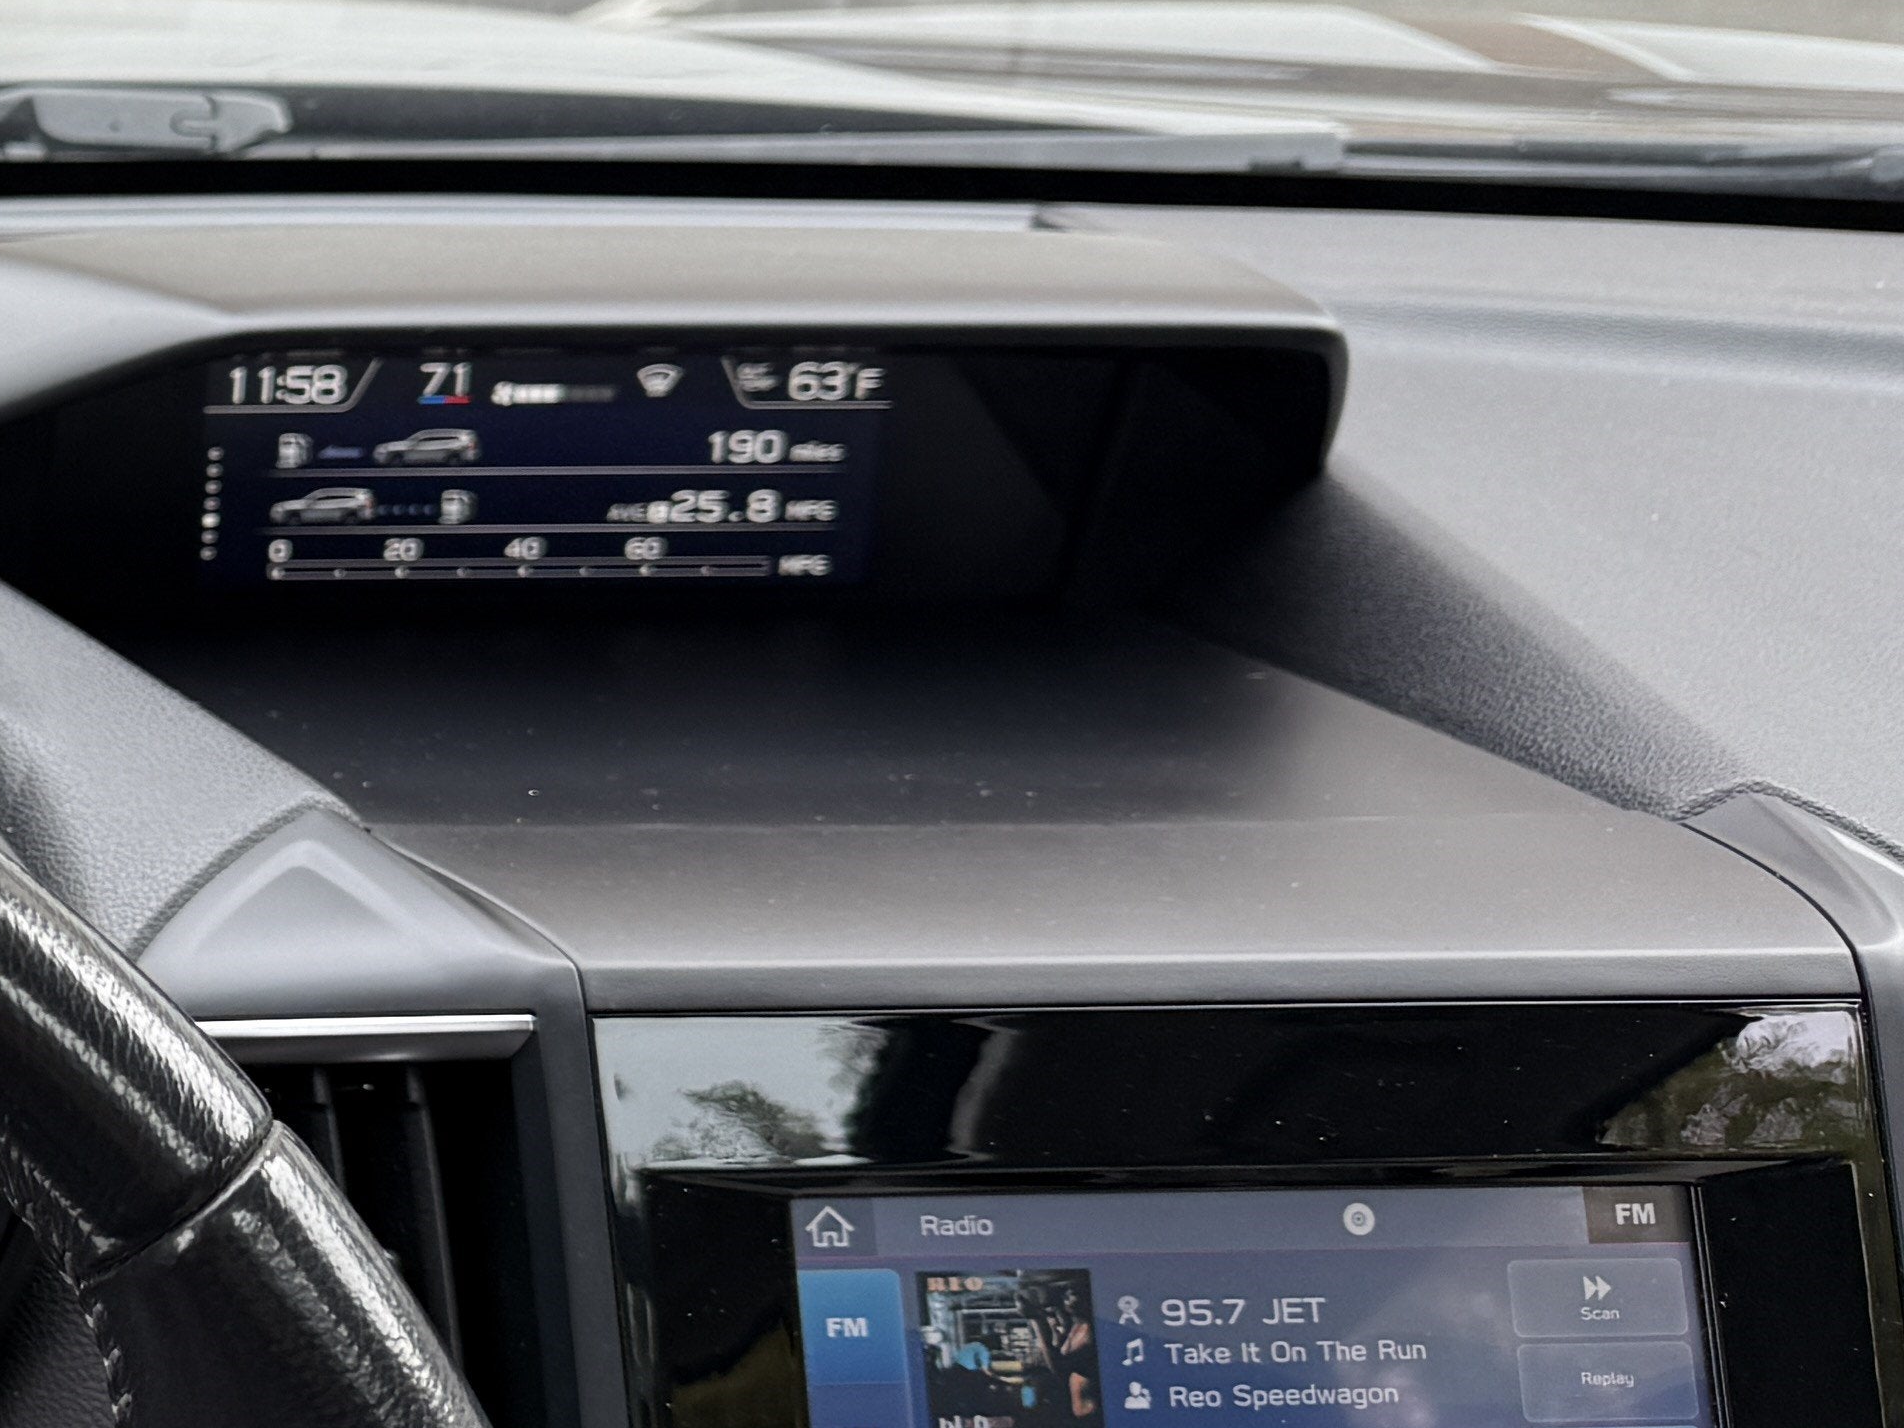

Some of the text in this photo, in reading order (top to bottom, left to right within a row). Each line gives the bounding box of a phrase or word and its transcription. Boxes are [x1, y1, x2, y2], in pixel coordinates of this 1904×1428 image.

[229, 364, 348, 405] 11:58
[419, 361, 472, 397] 71
[708, 429, 789, 464] 190
[670, 489, 784, 523] 25.8
[383, 537, 423, 562] 20
[504, 536, 548, 561] 40
[624, 536, 669, 561] 60
[920, 1214, 994, 1237] Radio
[1614, 1202, 1656, 1225] FM
[1160, 1297, 1326, 1327] 95.7 JET
[1580, 1306, 1620, 1321] Scan
[826, 1316, 869, 1338] FM
[1163, 1340, 1427, 1365] Take It On The Run
[1581, 1371, 1634, 1388] Replay
[1168, 1384, 1399, 1411] Reo Speedwagon
